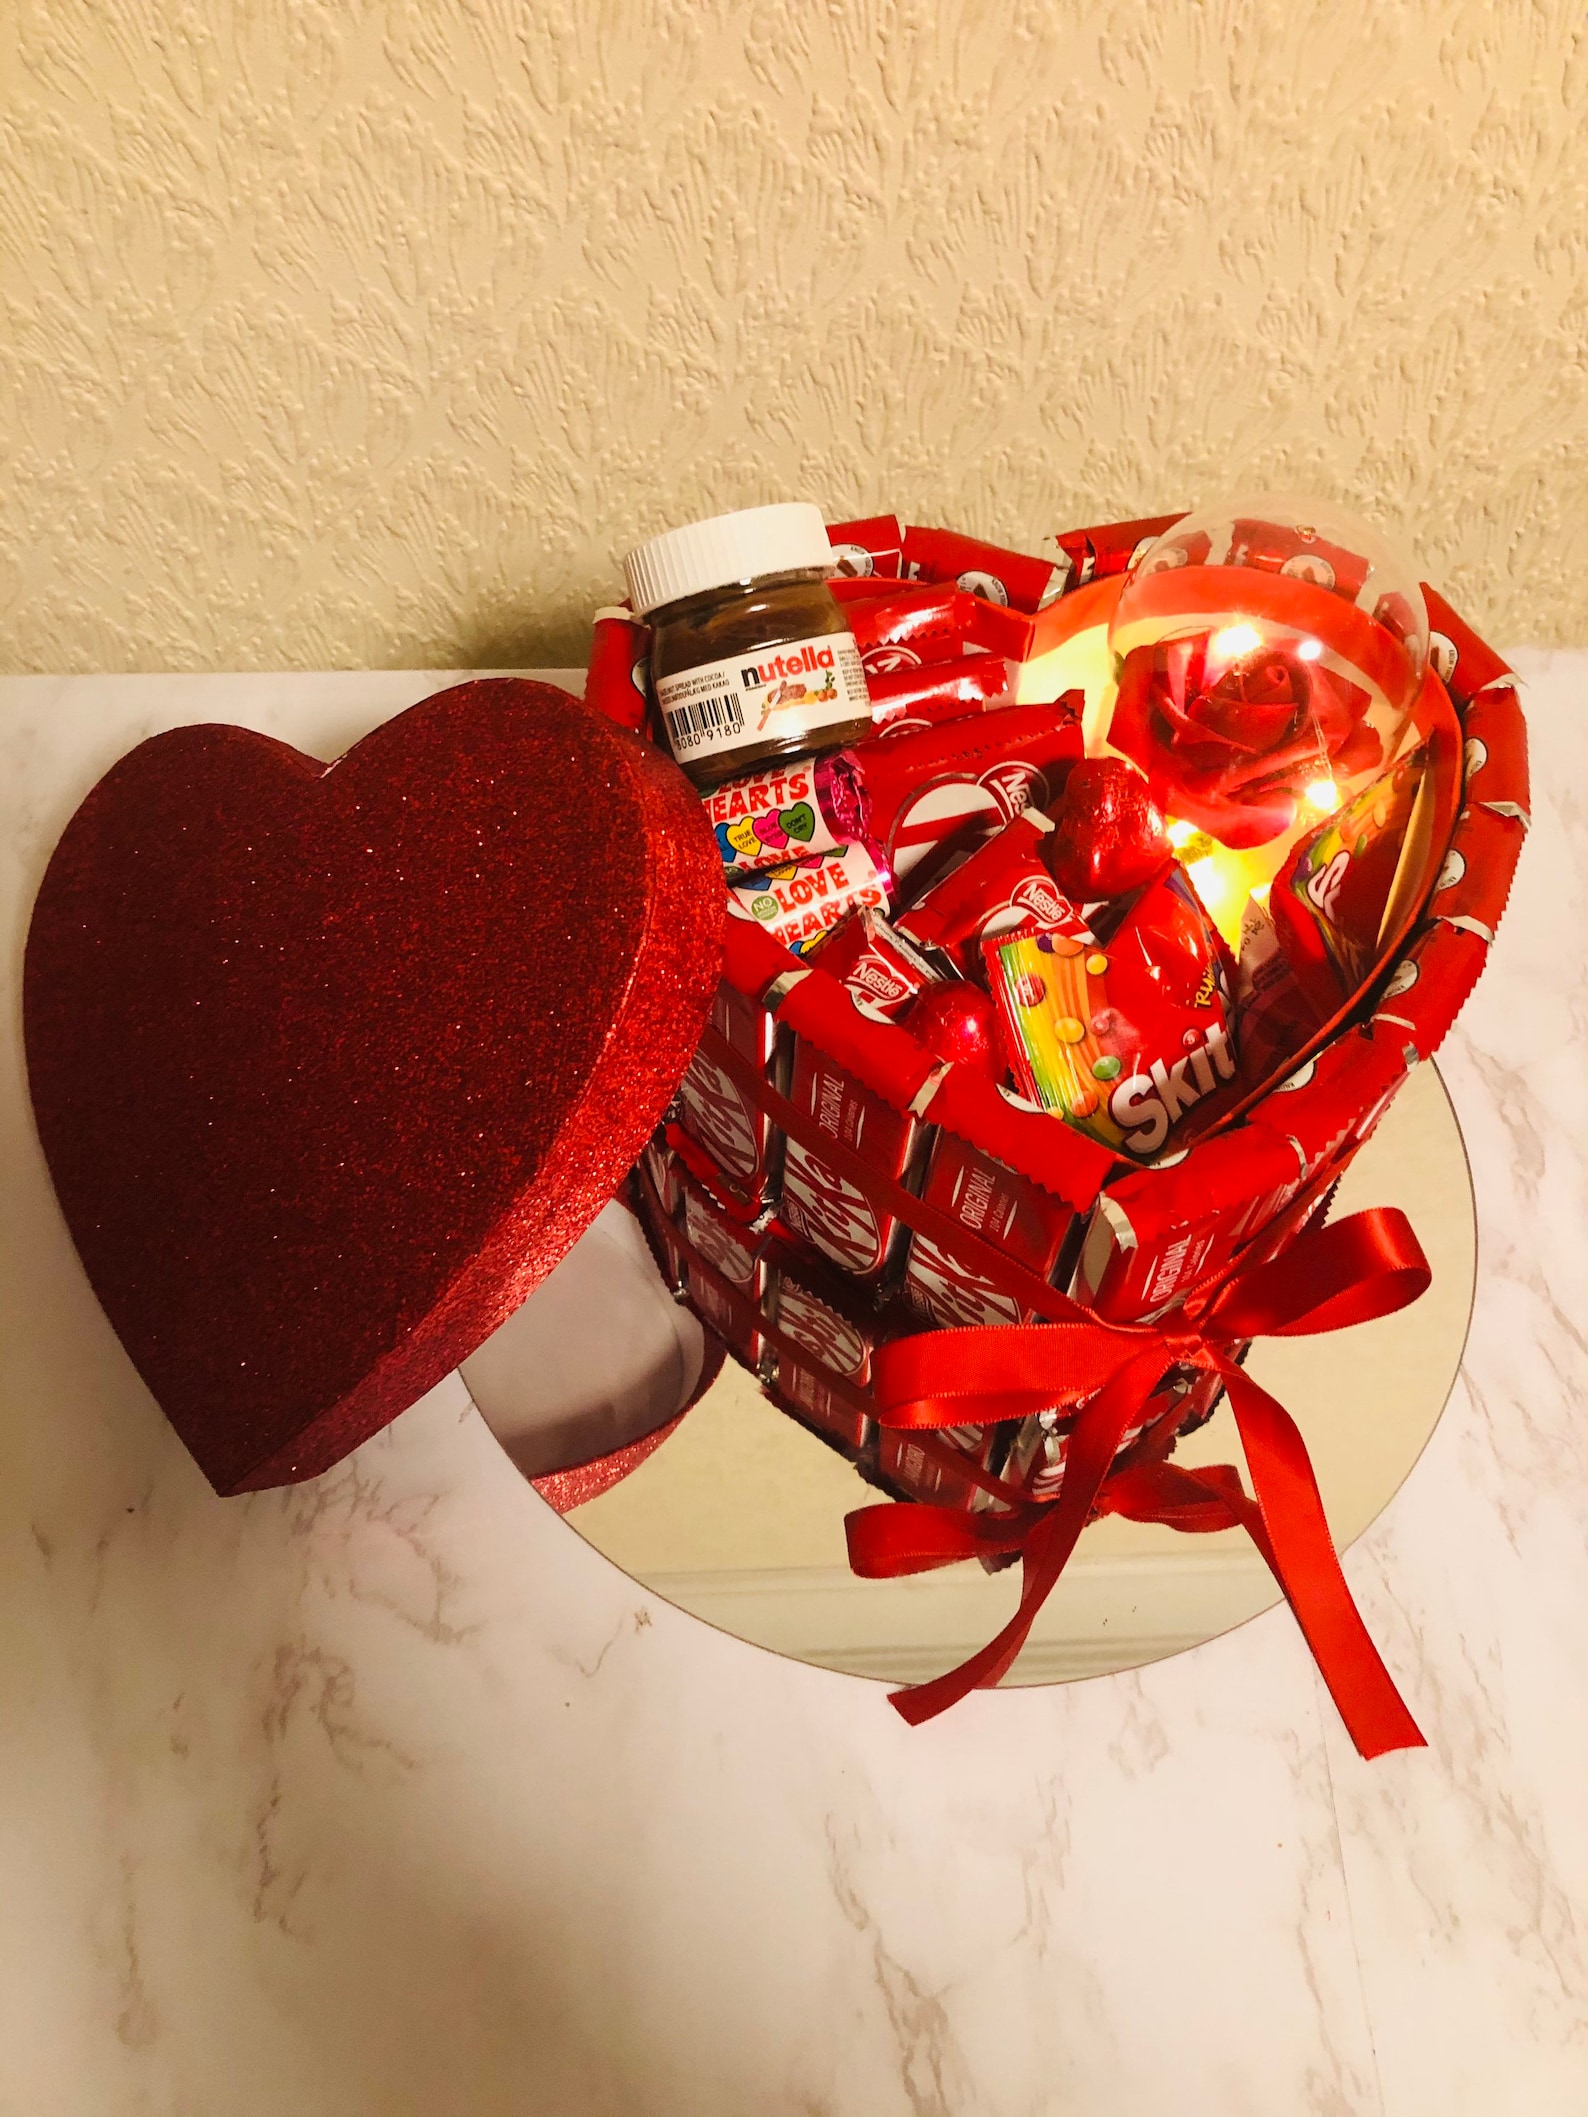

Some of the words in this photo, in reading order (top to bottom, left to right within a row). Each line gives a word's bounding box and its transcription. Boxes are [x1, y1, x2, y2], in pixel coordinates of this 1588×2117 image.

[692, 676, 705, 686] WITH
[704, 672, 723, 683] COCOA
[741, 646, 834, 687] nutella
[700, 684, 712, 693] MED
[712, 679, 730, 689] KAKAO
[706, 722, 741, 741] 9180
[733, 829, 752, 842] TRUE
[738, 837, 757, 849] LOVE
[773, 862, 850, 914] LOVE
[753, 897, 773, 912] NO
[818, 1073, 845, 1140] ORIGINAL
[786, 1145, 878, 1270] KitKa
[958, 1167, 995, 1230] ORIGINAL
[1150, 1233, 1192, 1302] ORIGINAL
